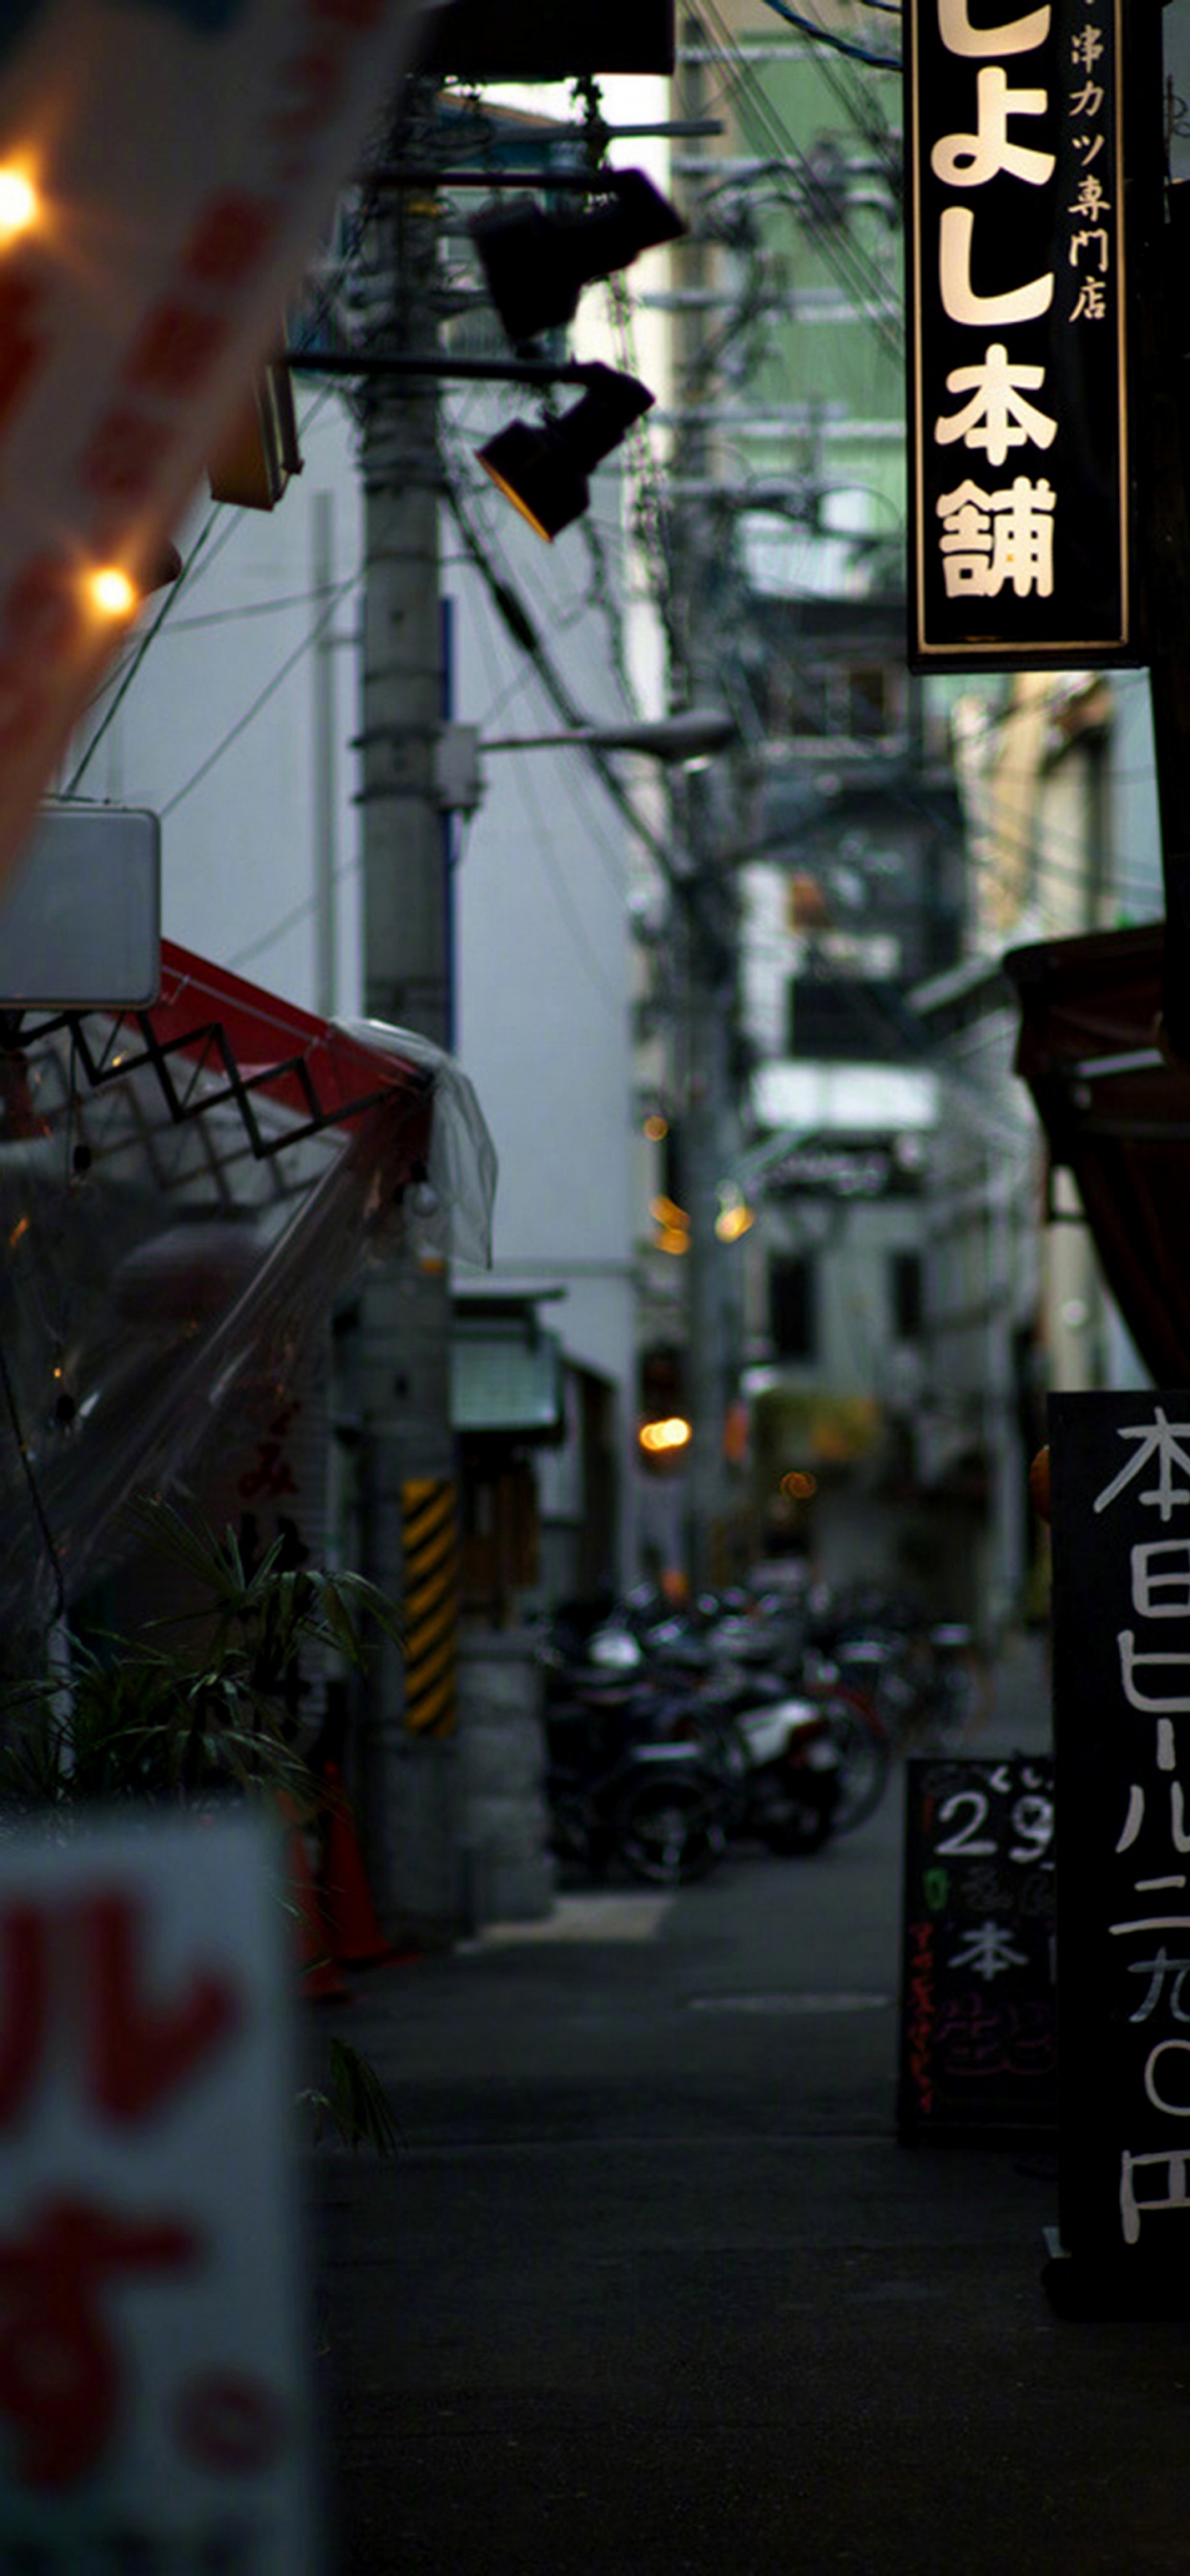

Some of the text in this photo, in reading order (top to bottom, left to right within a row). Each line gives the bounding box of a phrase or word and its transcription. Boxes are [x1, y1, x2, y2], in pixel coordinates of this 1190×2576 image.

[1066, 0, 1111, 323] 串カツ専門店
